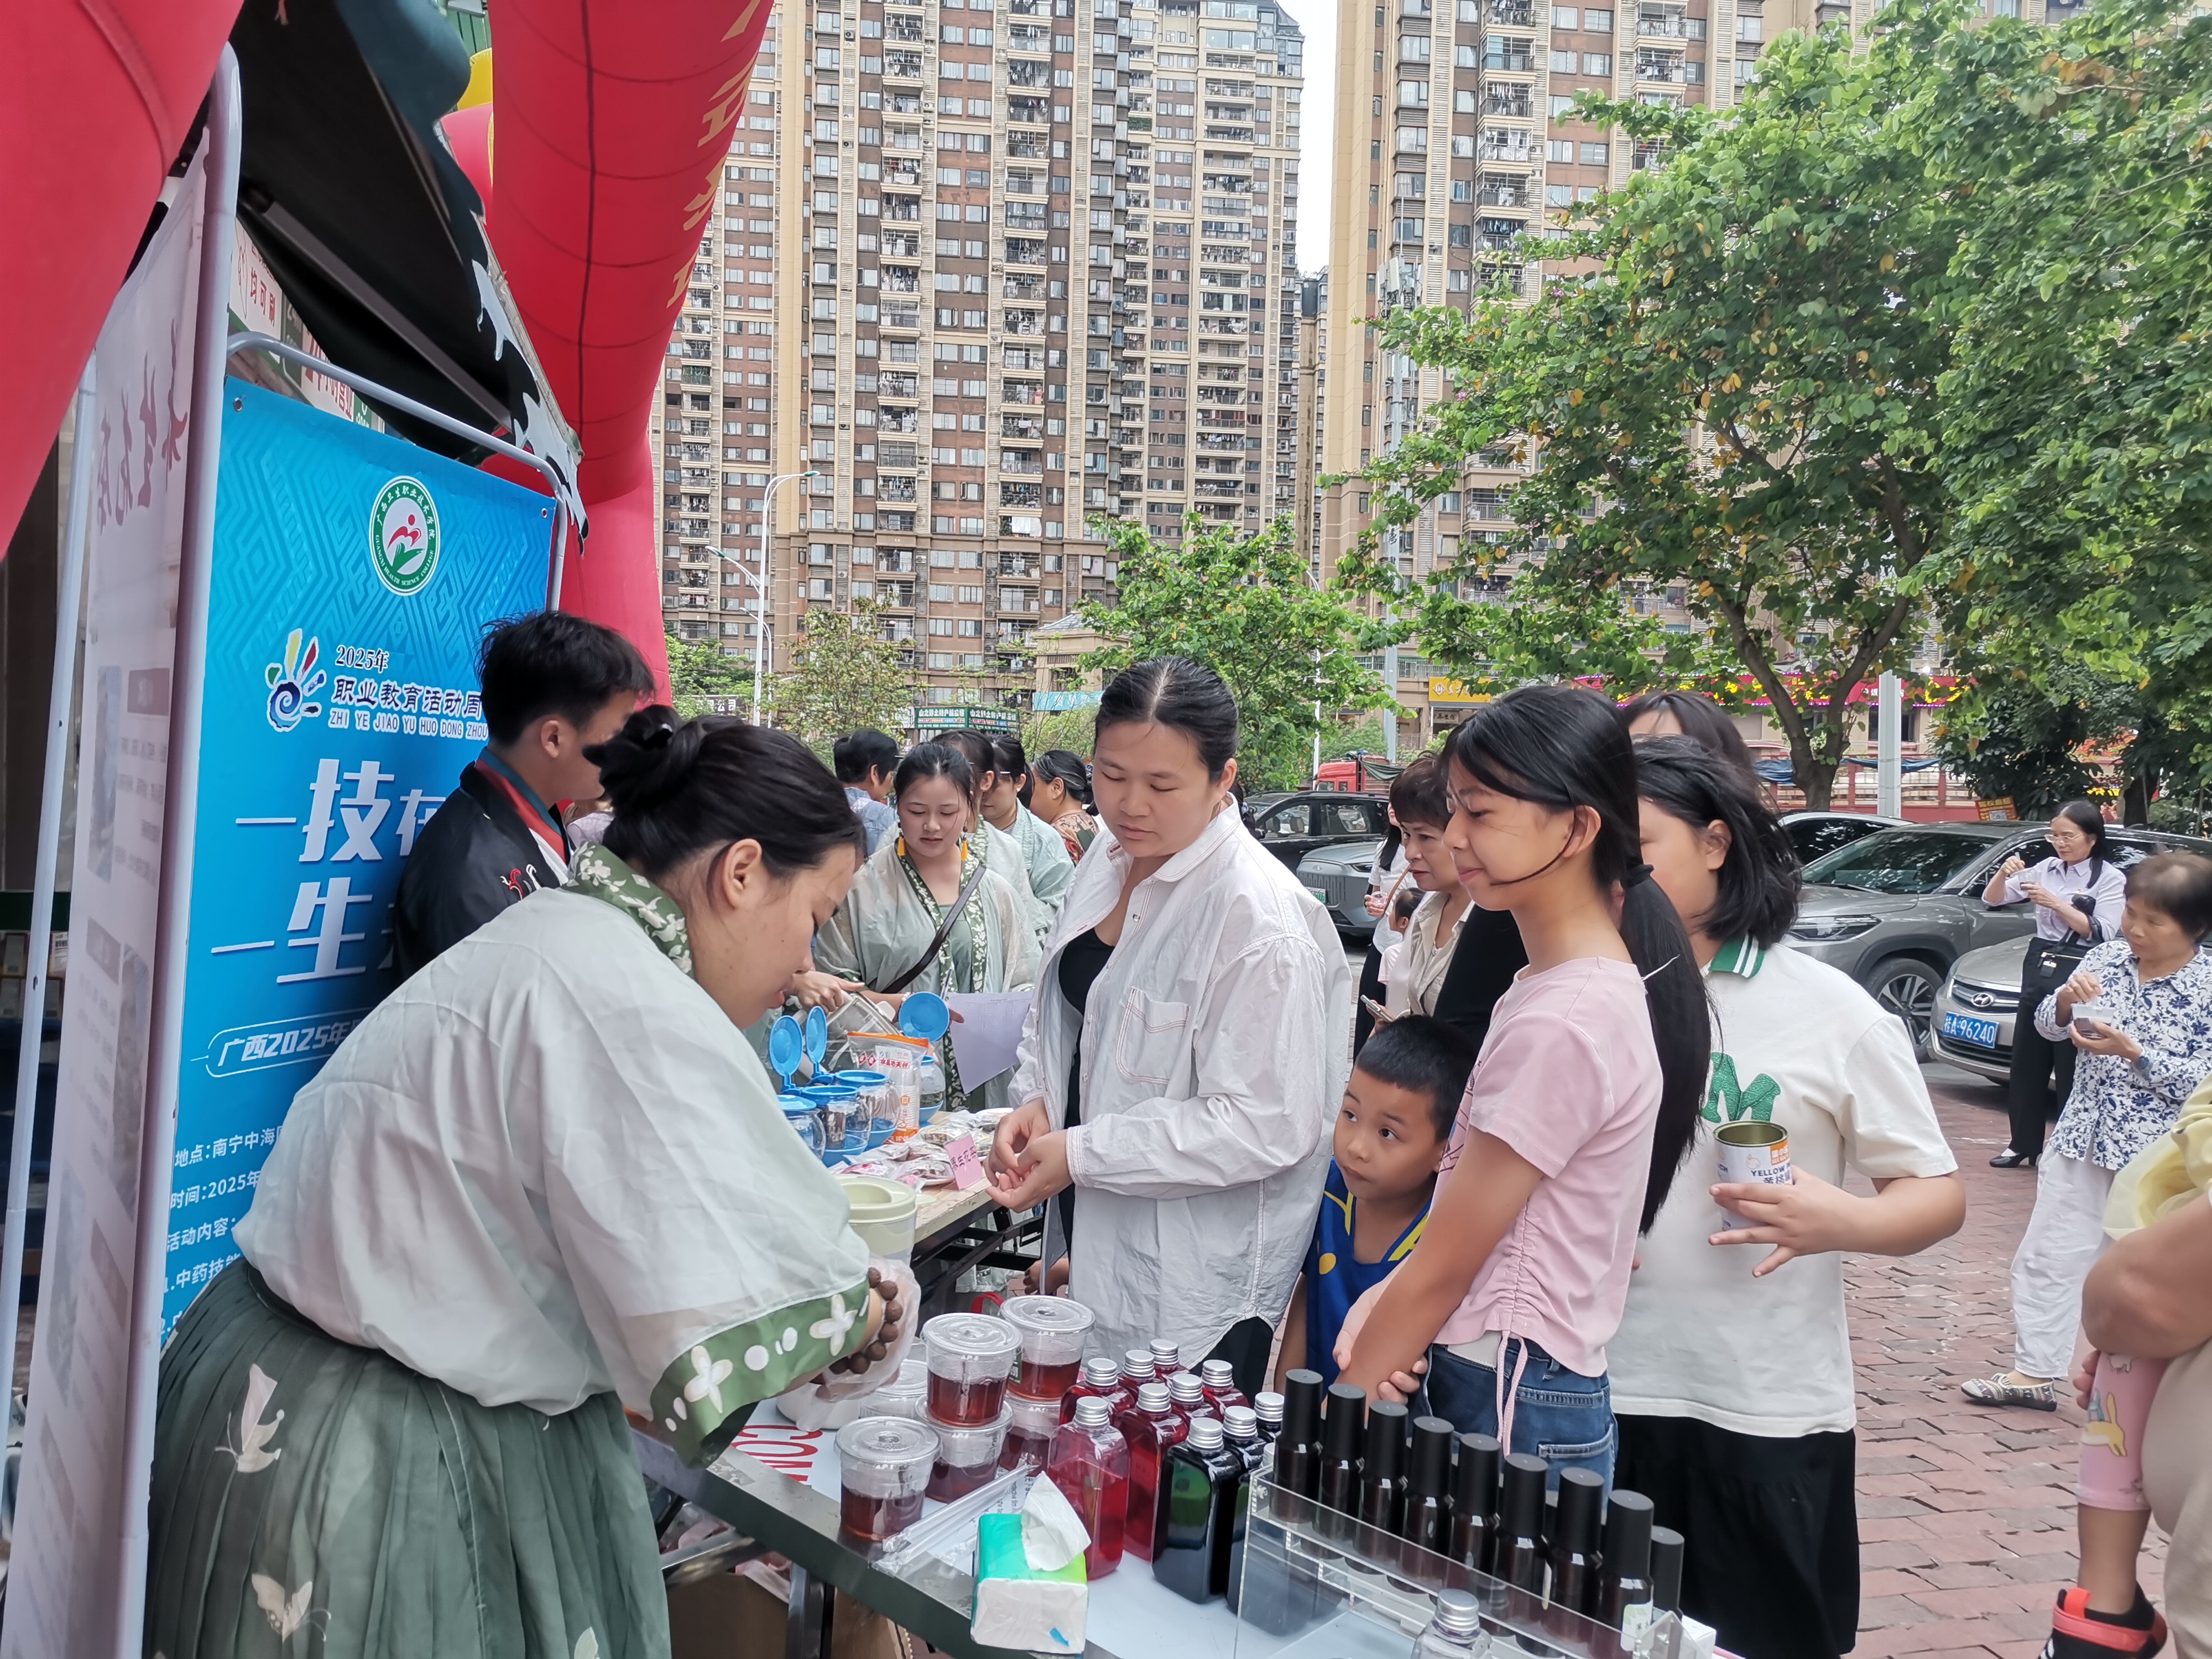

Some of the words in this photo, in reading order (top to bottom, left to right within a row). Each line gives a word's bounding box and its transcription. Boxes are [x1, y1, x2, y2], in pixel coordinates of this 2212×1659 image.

[377, 485, 435, 540] 广西卫生职业技术学院
[384, 566, 400, 585] HEALTH
[401, 575, 420, 586] SCIENCE
[421, 549, 434, 577] COLLEGE
[336, 646, 389, 672] 2025年
[333, 678, 482, 719] 职业教育活动周
[330, 711, 348, 726] ZHI
[357, 713, 368, 727] YE
[375, 714, 398, 731] JIAO
[404, 717, 416, 732] YU
[420, 719, 437, 733] HUO
[442, 723, 462, 735] DONG
[467, 724, 487, 738] ZHOU
[211, 877, 394, 983] 一生
[1751, 1165, 1785, 1177] YELLOW
